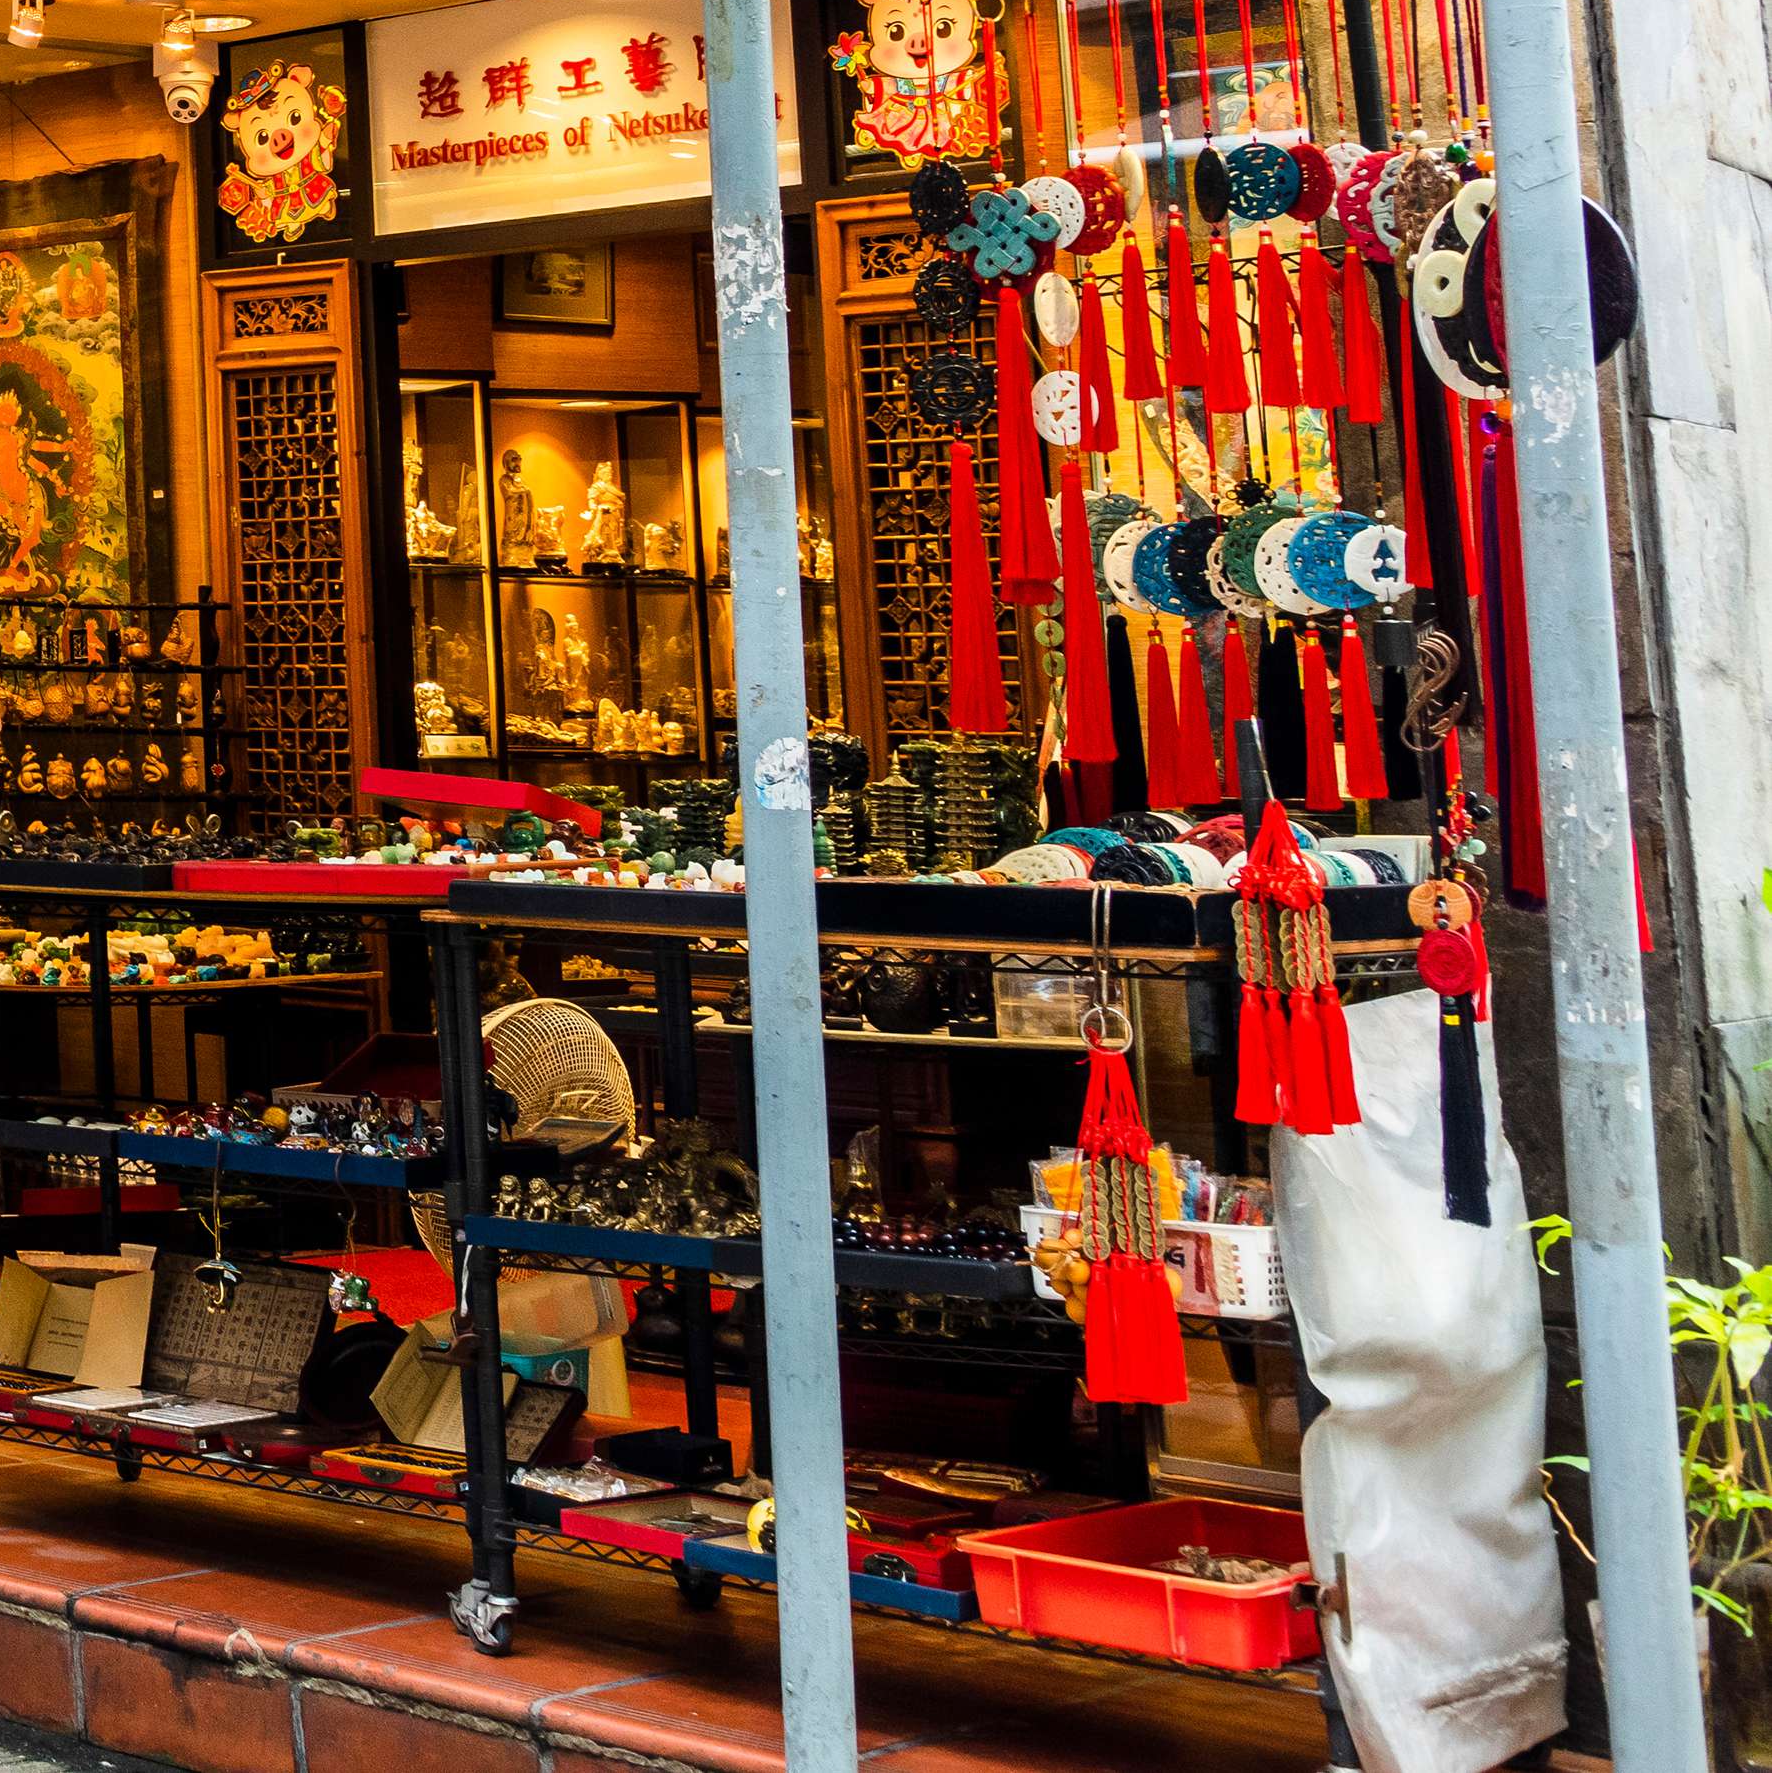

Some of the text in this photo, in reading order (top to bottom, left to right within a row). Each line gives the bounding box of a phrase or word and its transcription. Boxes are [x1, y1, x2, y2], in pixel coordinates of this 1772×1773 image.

[389, 103, 709, 172] Masterpieces of Netsuke
